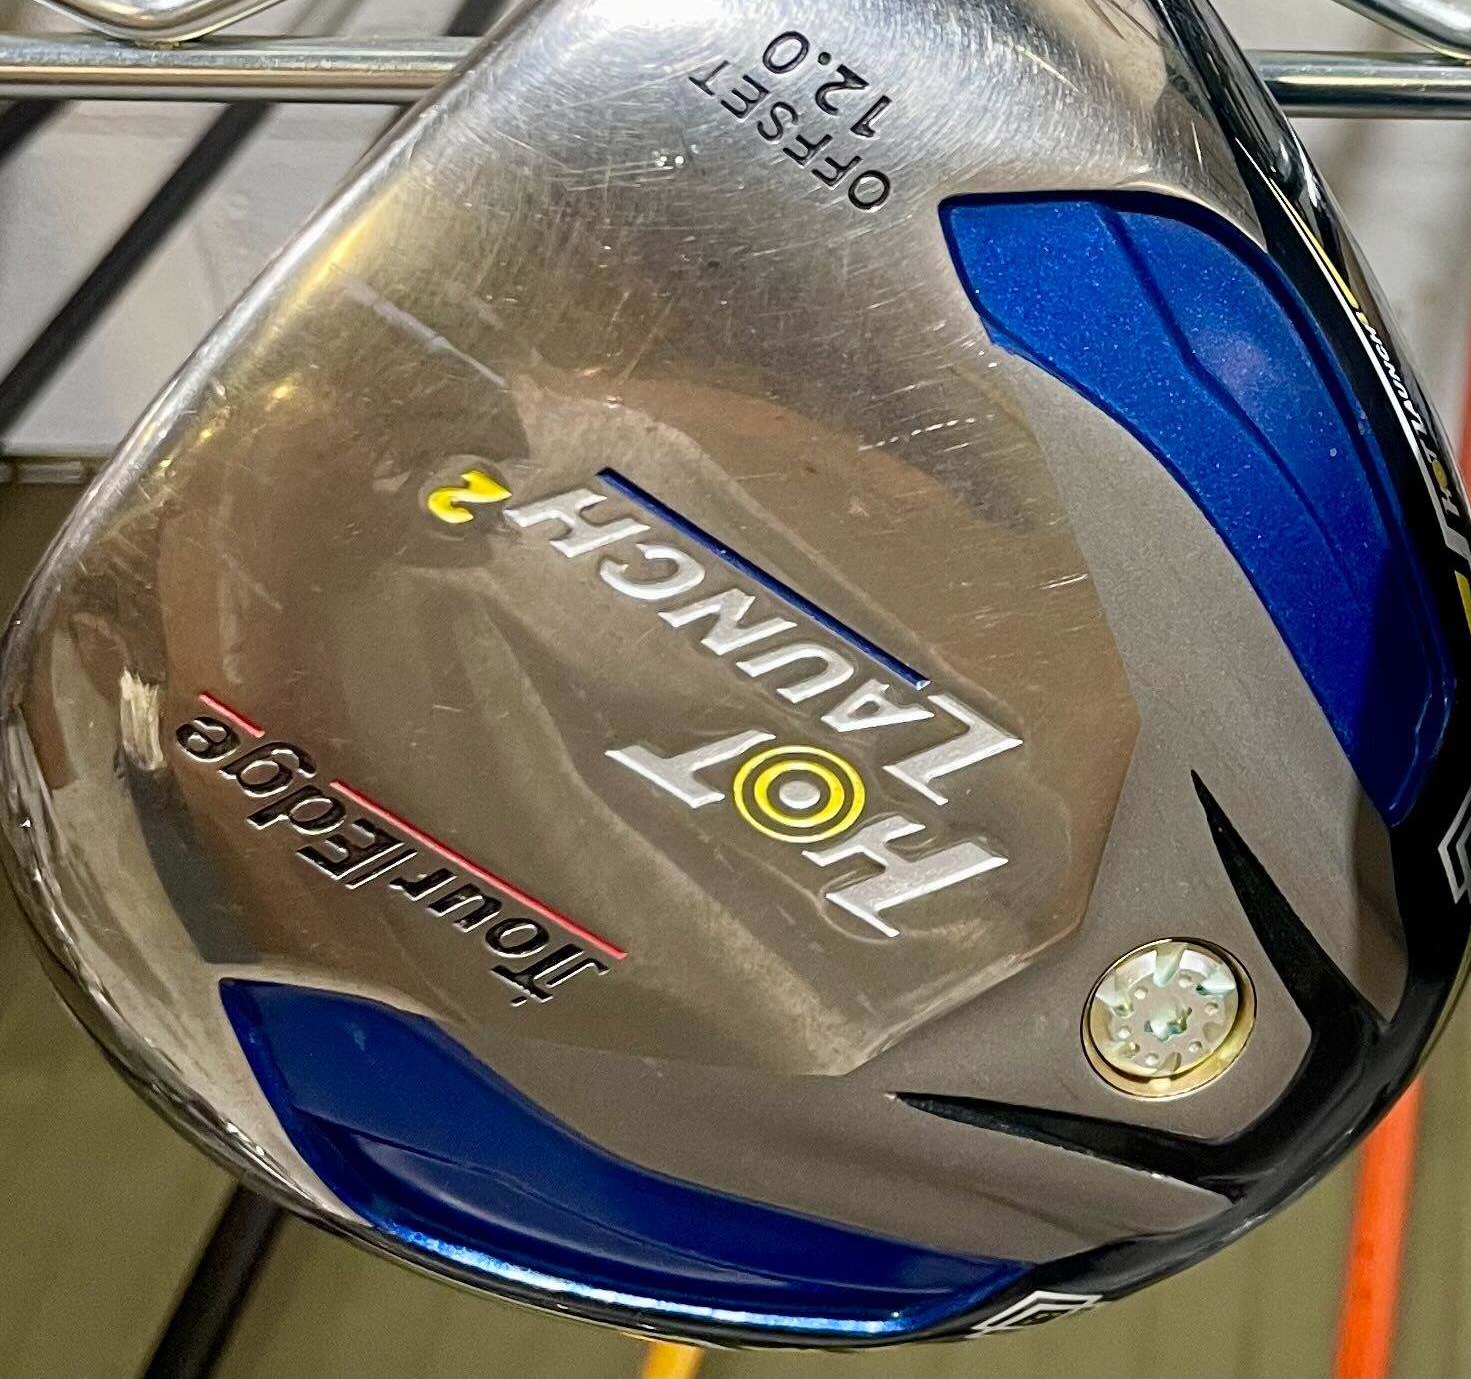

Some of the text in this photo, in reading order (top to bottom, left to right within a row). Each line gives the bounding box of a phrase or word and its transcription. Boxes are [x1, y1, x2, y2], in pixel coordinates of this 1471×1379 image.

[688, 59, 892, 212] OFFSET
[762, 30, 893, 138] 12.0
[427, 469, 1024, 806] LAUNCH 2
[605, 729, 1010, 939] HOT
